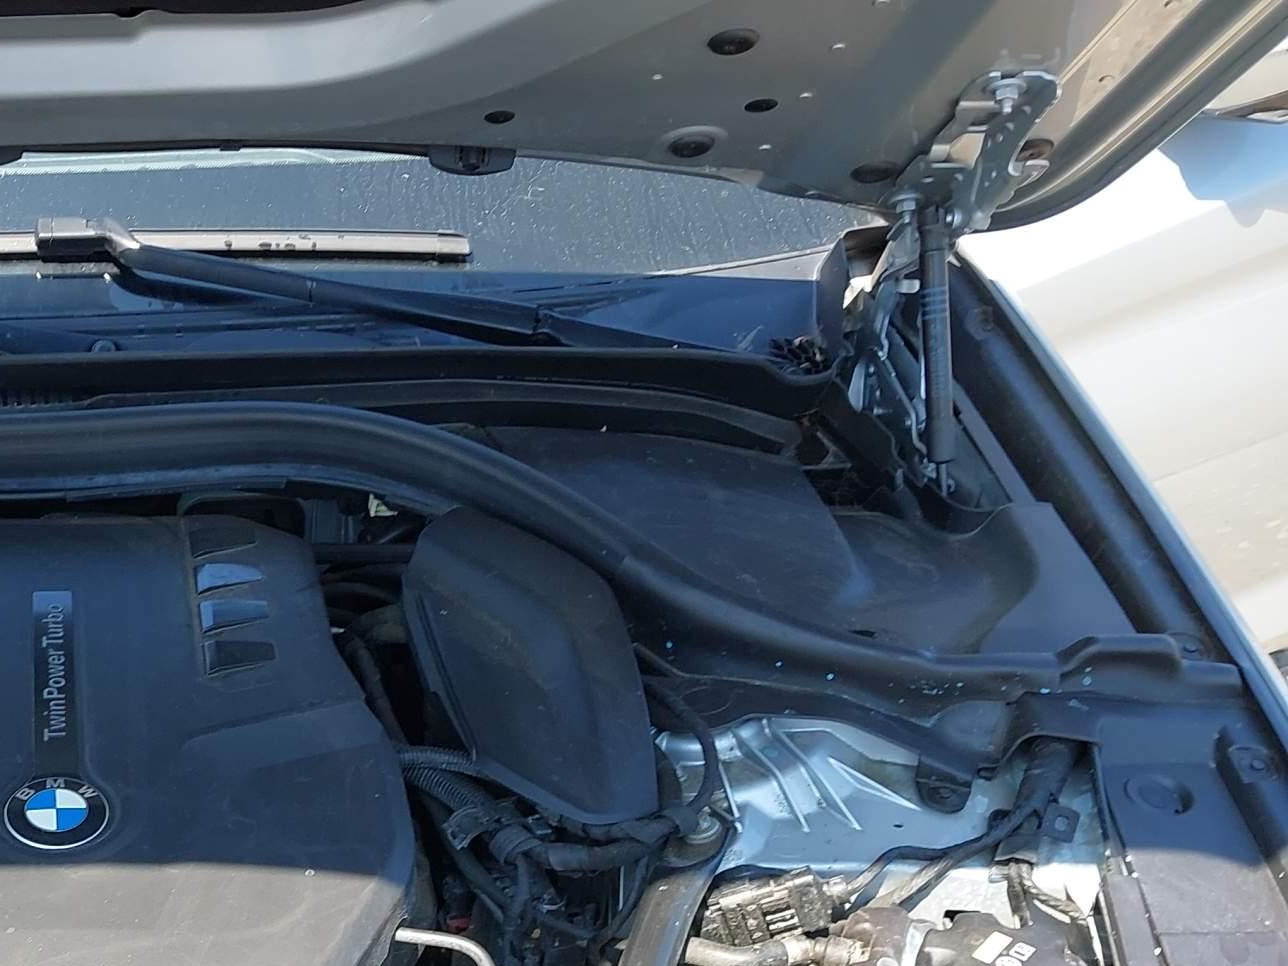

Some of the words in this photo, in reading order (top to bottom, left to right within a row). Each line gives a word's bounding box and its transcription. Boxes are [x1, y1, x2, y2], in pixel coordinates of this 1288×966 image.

[41, 603, 65, 648] Turbo
[43, 648, 67, 742] TwinPower
[15, 777, 99, 801] BMW
